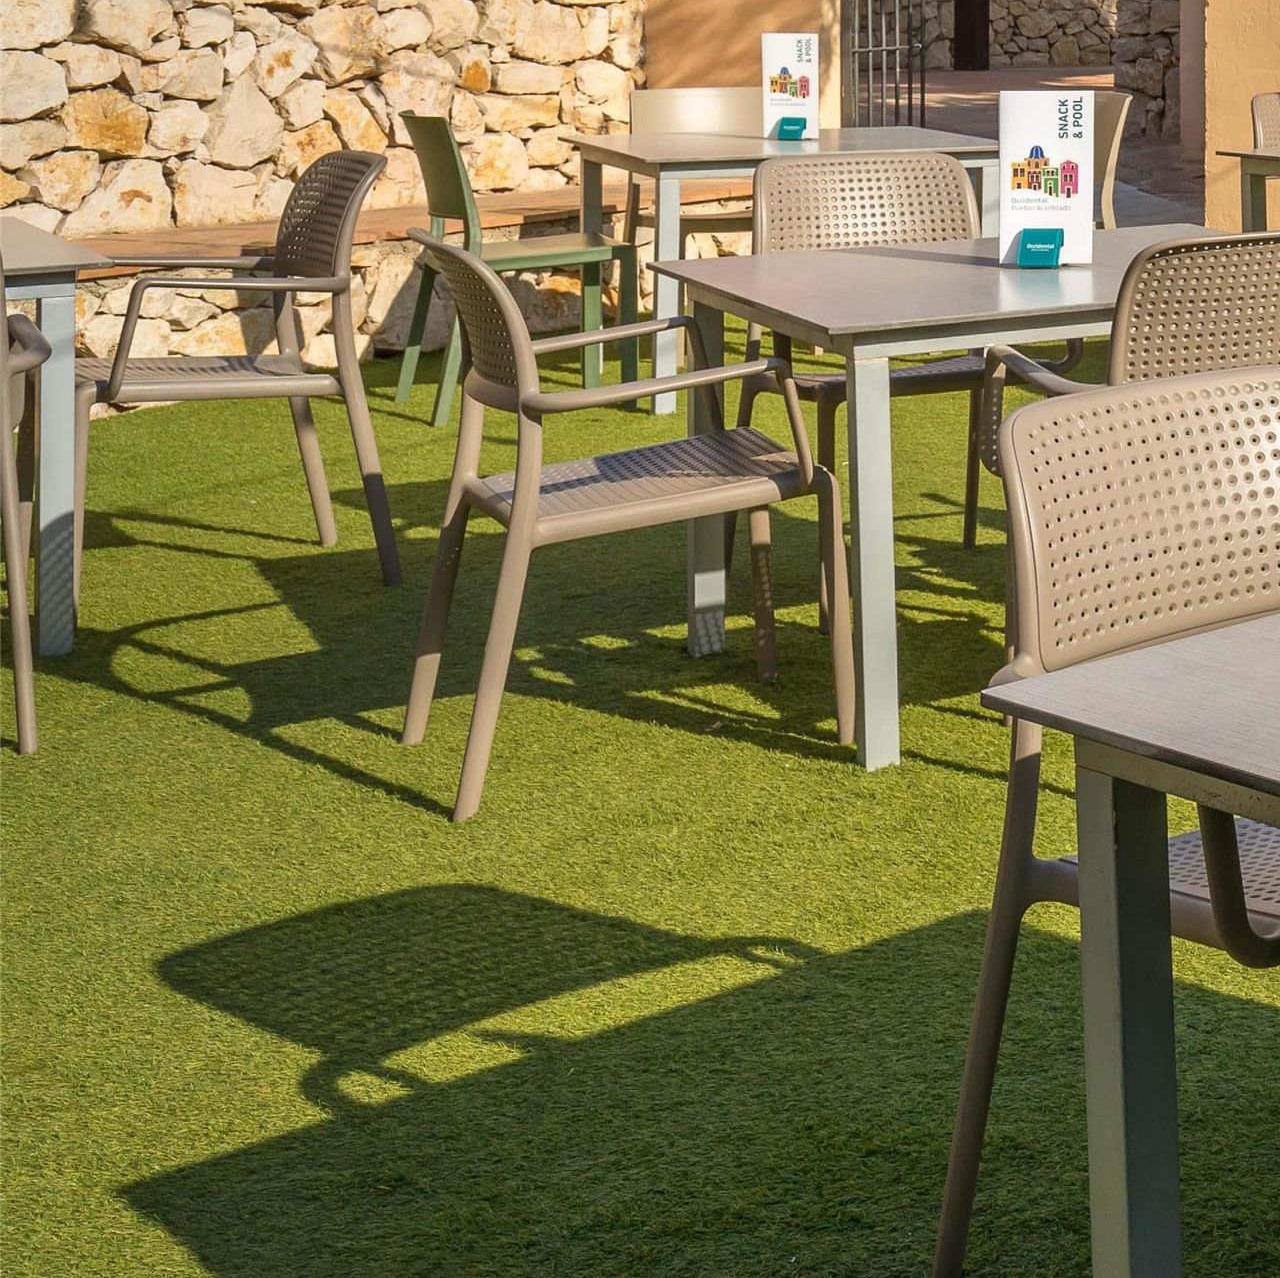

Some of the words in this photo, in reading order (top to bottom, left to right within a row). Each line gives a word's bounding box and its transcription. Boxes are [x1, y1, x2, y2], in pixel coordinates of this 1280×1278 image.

[1058, 98, 1069, 139] SNACK
[1072, 96, 1083, 129] POOL
[1072, 130, 1083, 139] &
